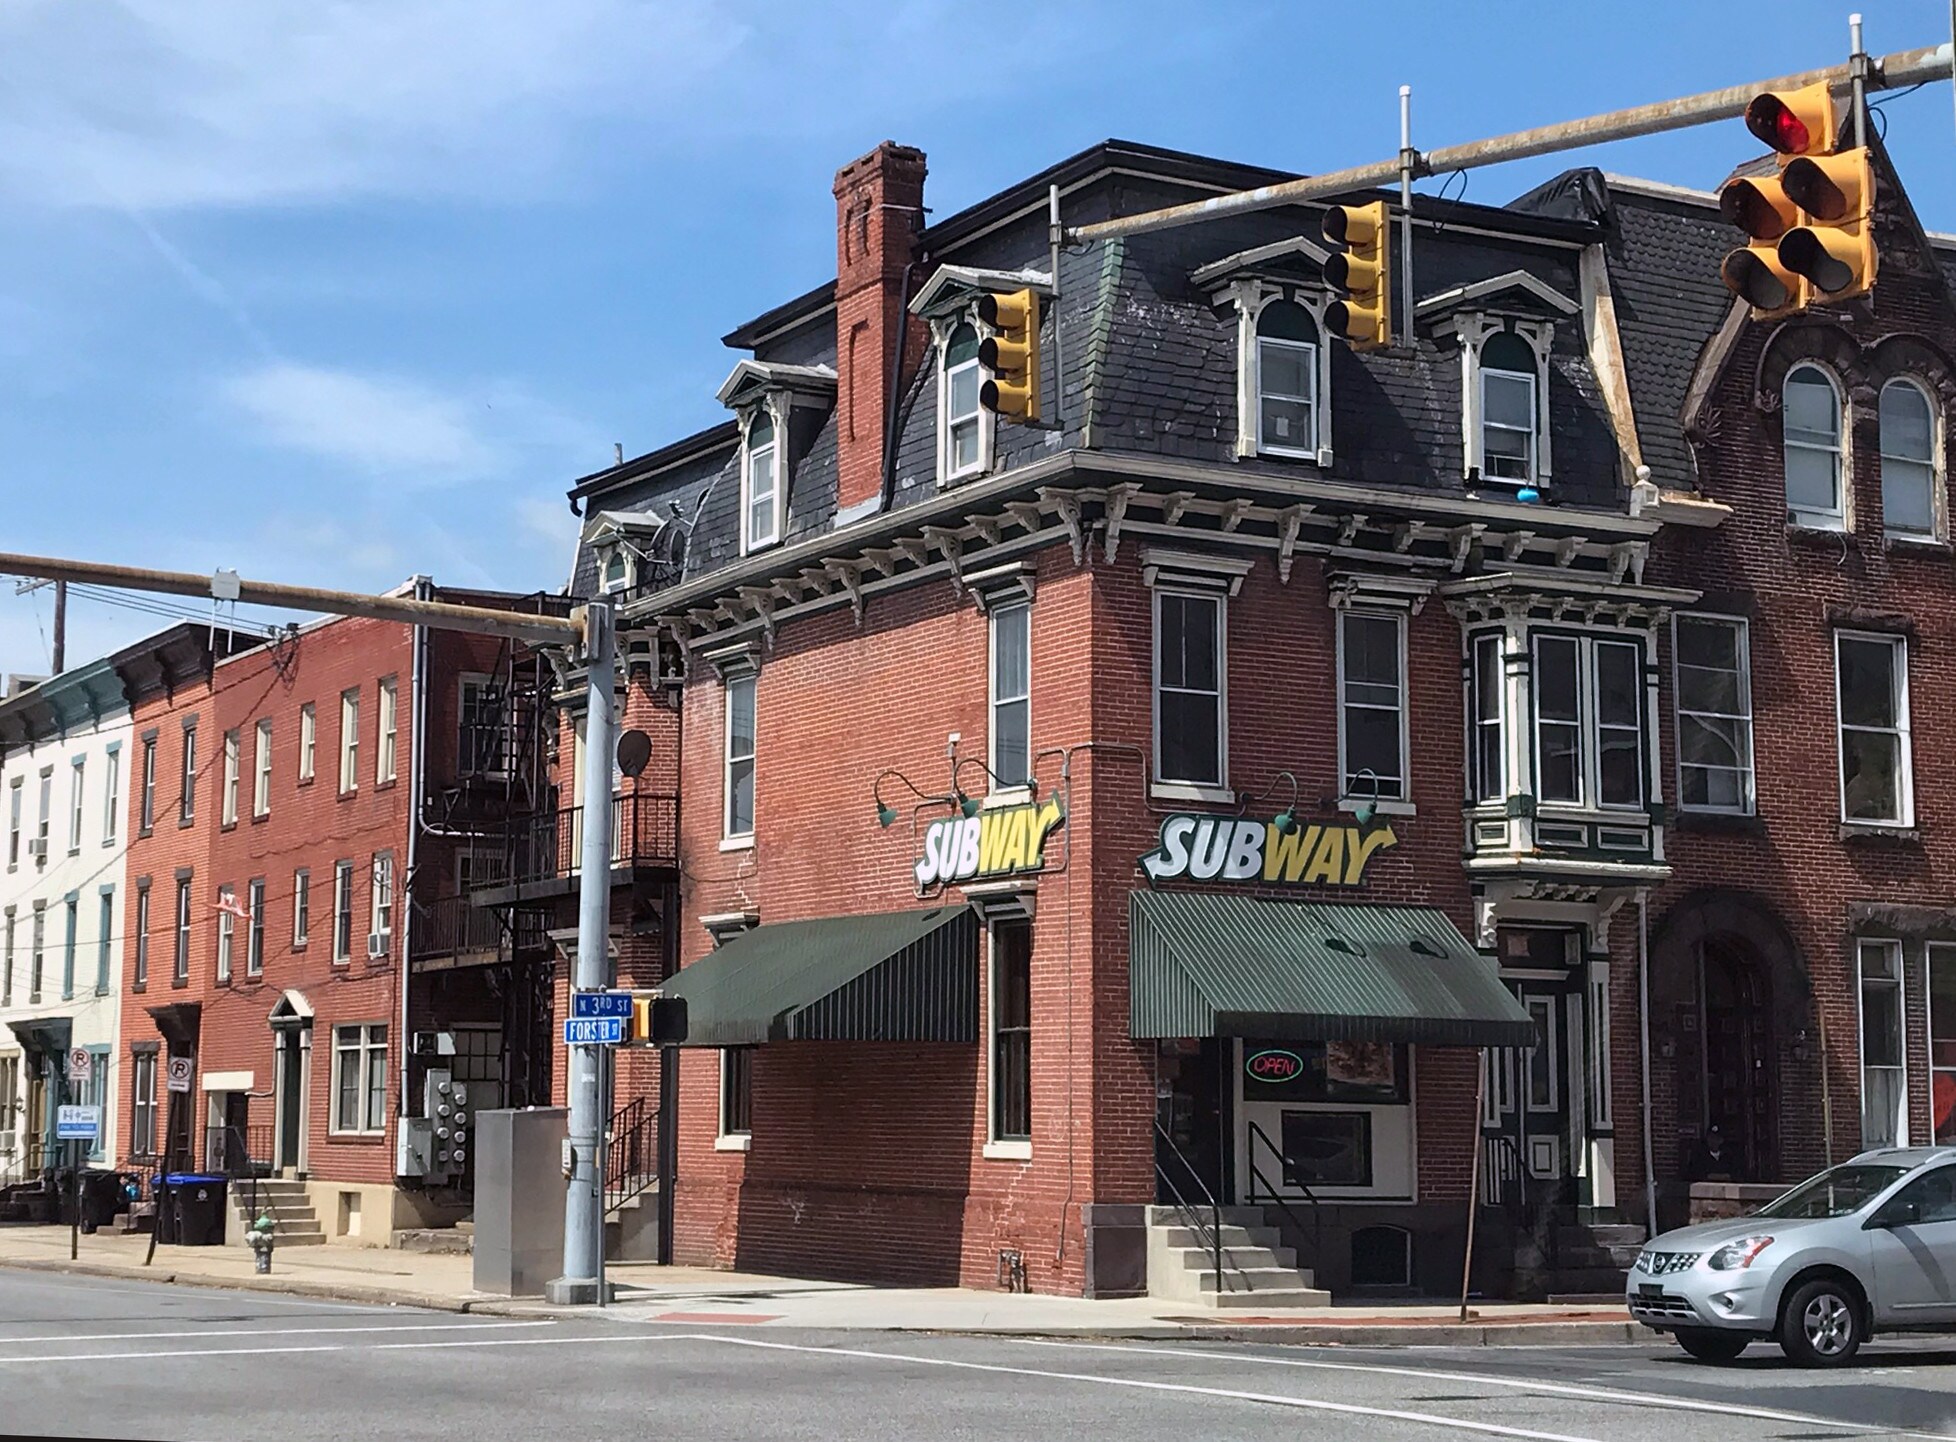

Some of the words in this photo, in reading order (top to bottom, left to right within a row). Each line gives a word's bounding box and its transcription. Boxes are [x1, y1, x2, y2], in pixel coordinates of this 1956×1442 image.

[915, 797, 1062, 885] SUBWAY
[1143, 816, 1399, 885] SUBWAY
[580, 999, 587, 1012] N
[591, 996, 612, 1015] 3RD
[617, 999, 628, 1012] ST
[570, 1021, 610, 1041] FORSTER
[1253, 1057, 1296, 1076] OPEN
